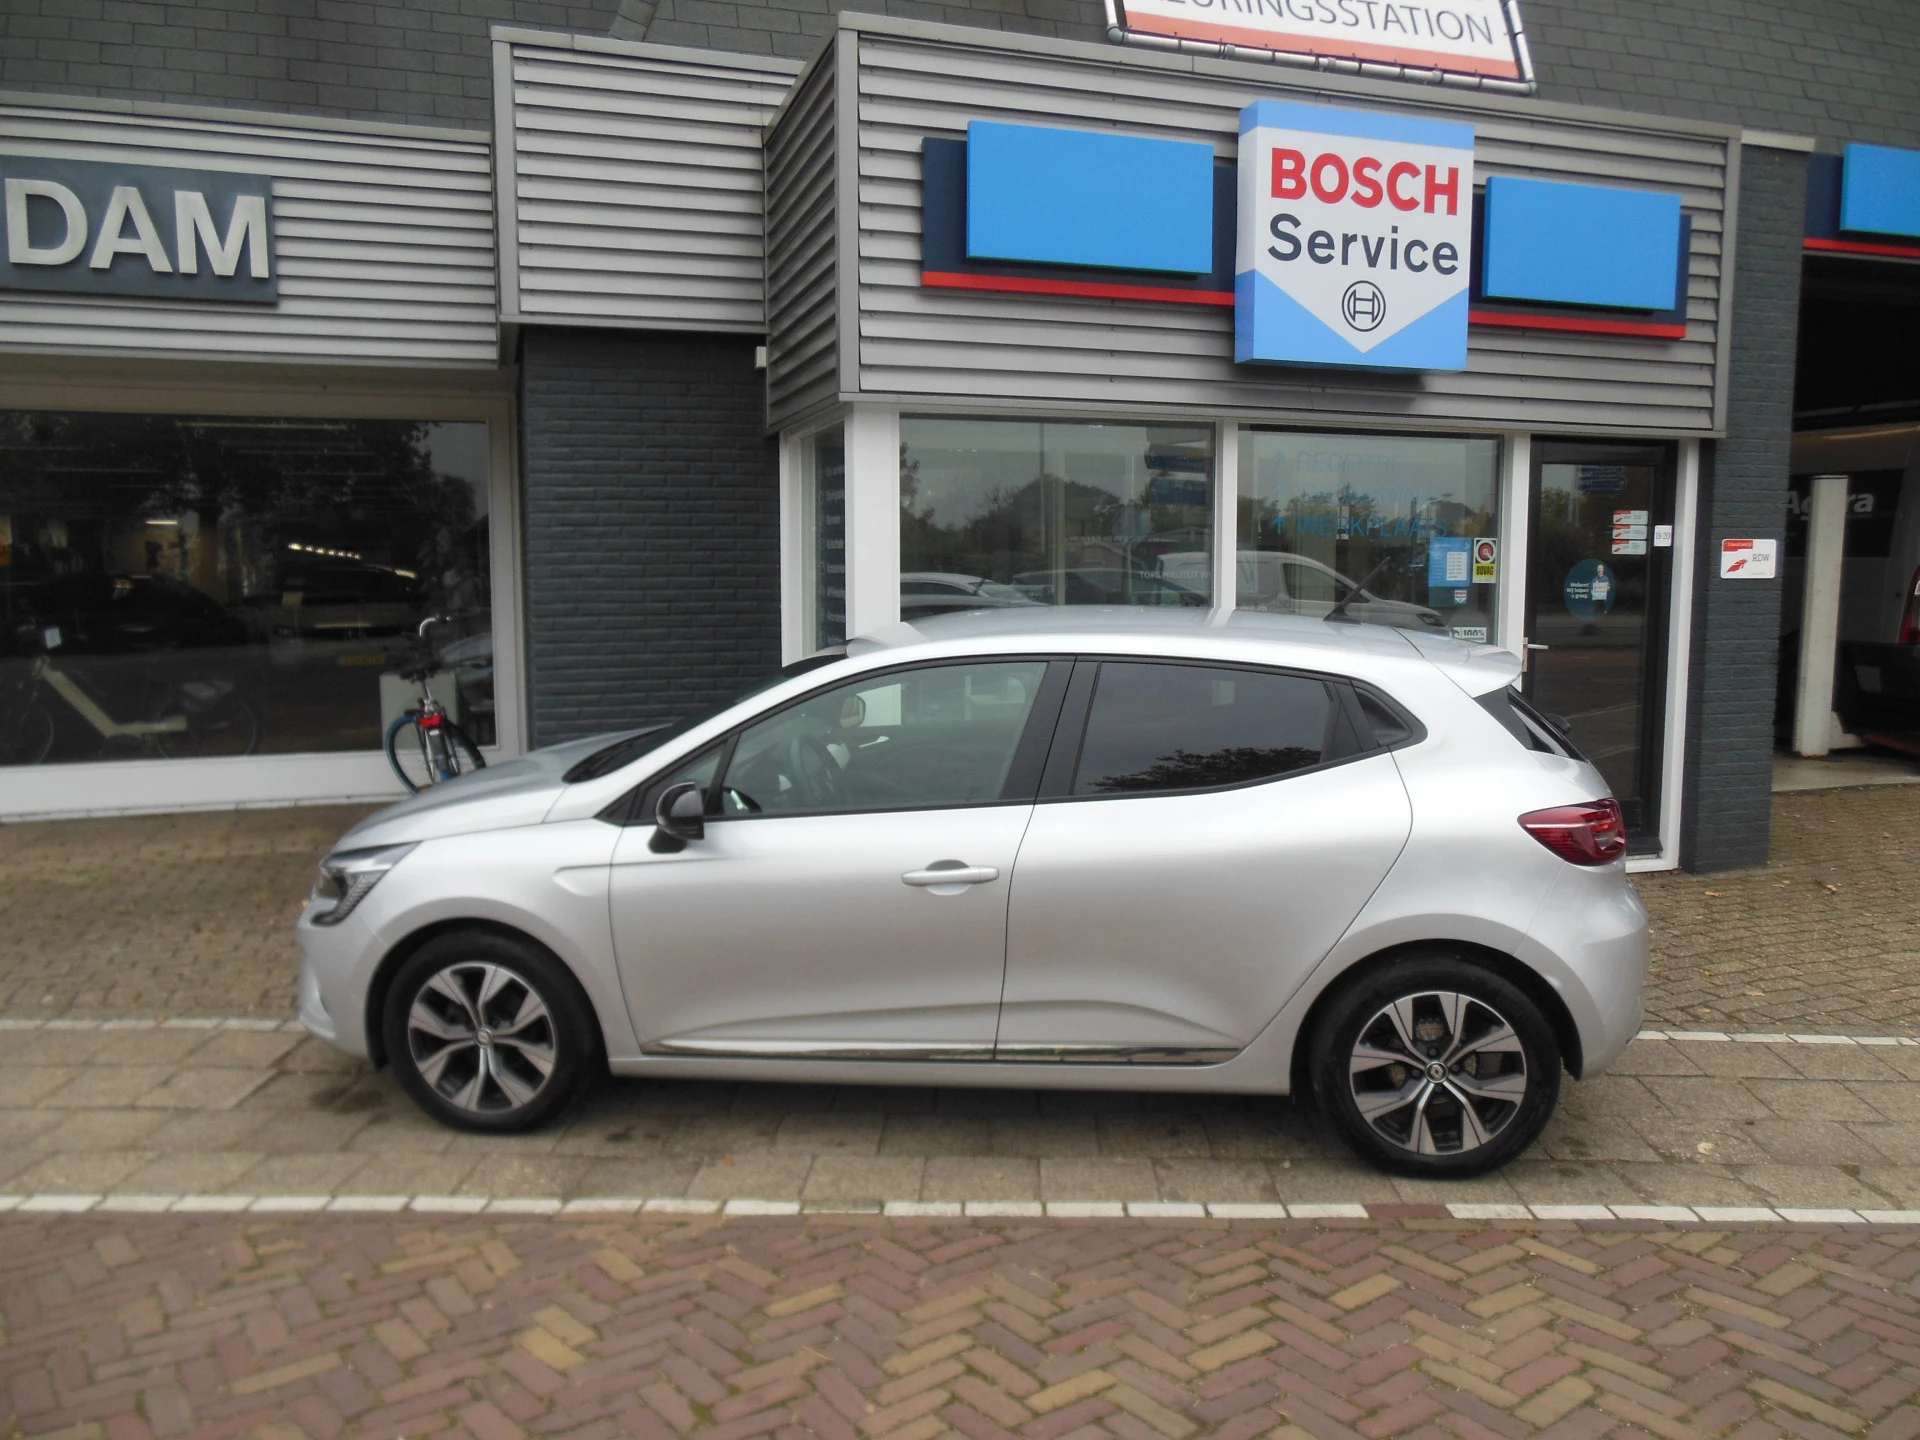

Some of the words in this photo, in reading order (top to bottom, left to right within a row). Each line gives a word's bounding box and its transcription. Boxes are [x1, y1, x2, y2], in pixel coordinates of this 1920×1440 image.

[1271, 147, 1459, 216] BOSCH
[5, 178, 269, 279] DAM
[1268, 213, 1459, 276] Service
[1297, 514, 1447, 538] WERKPLAATS
[1476, 565, 1494, 576] BOVAG
[1752, 553, 1770, 562] RDW
